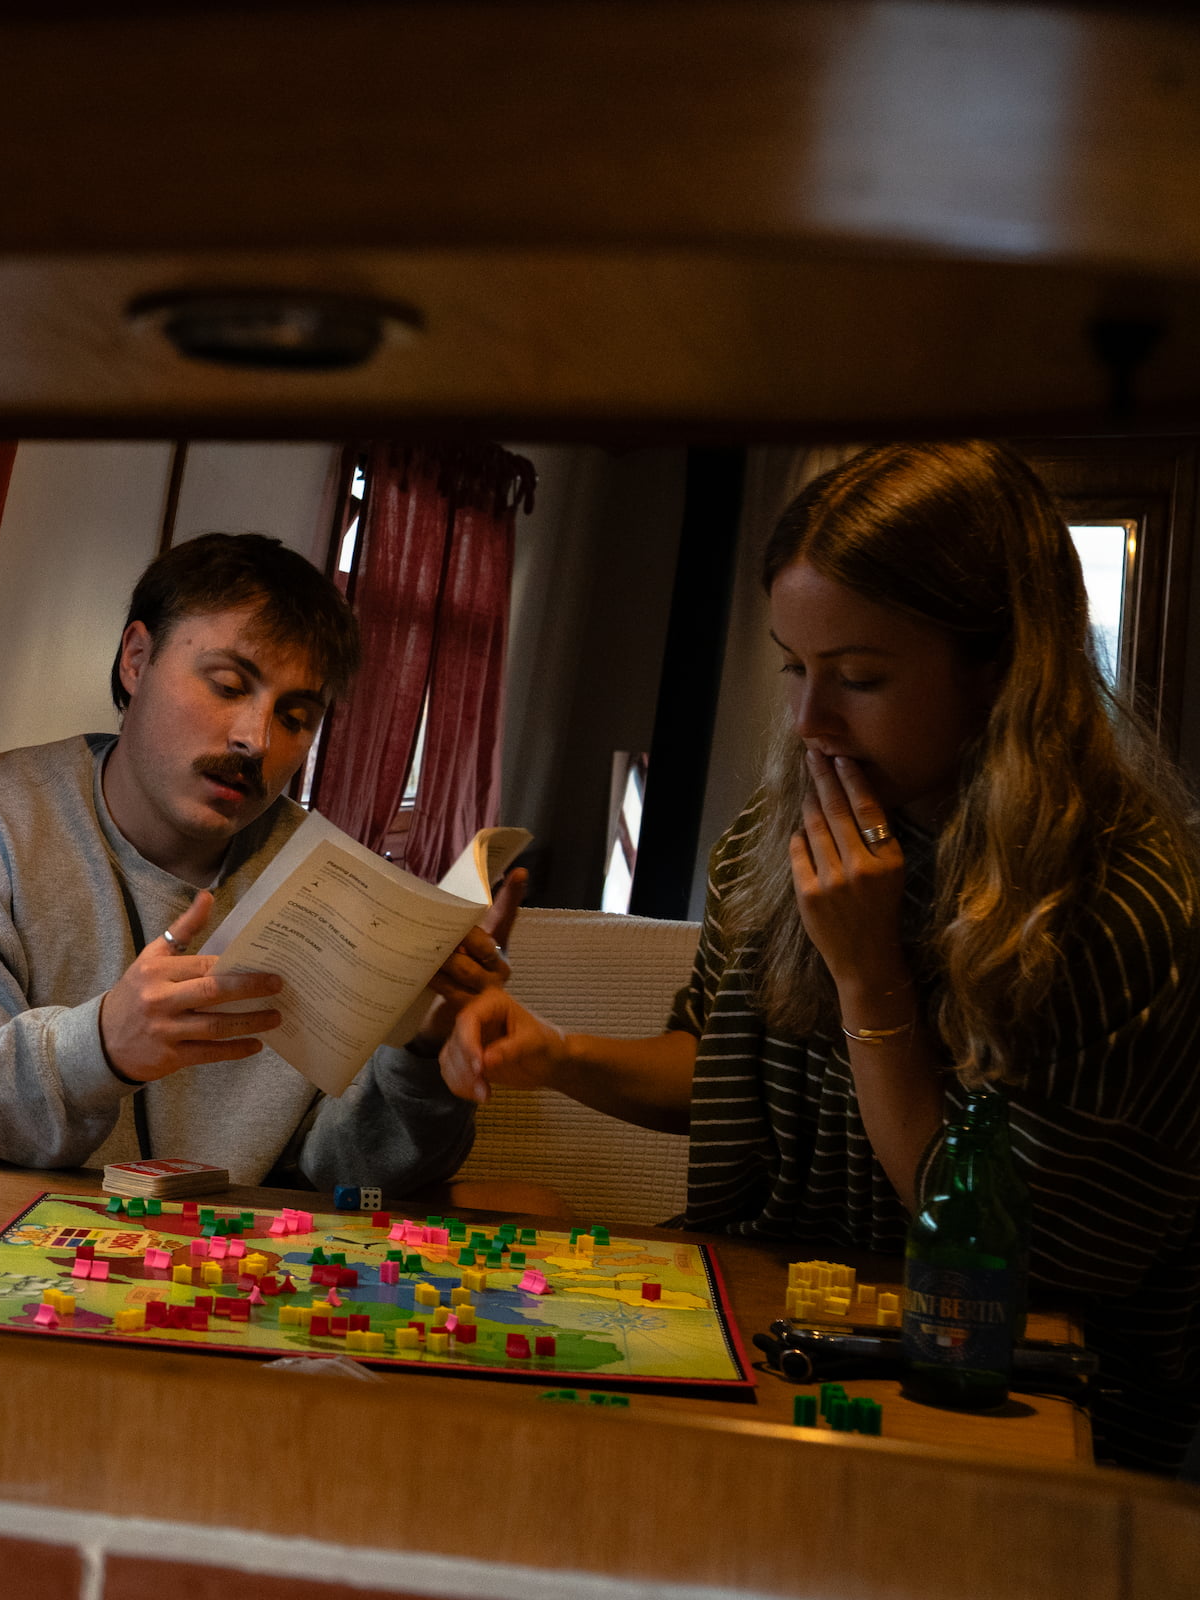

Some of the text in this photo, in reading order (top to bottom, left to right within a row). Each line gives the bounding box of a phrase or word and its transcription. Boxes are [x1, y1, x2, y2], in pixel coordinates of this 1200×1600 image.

[281, 925, 306, 939] PLAYER
[304, 937, 323, 953] GAME
[287, 900, 358, 950] CONDUCT OF THE GAME
[107, 1232, 144, 1251] RISK
[939, 1296, 1007, 1324] BERTIN
